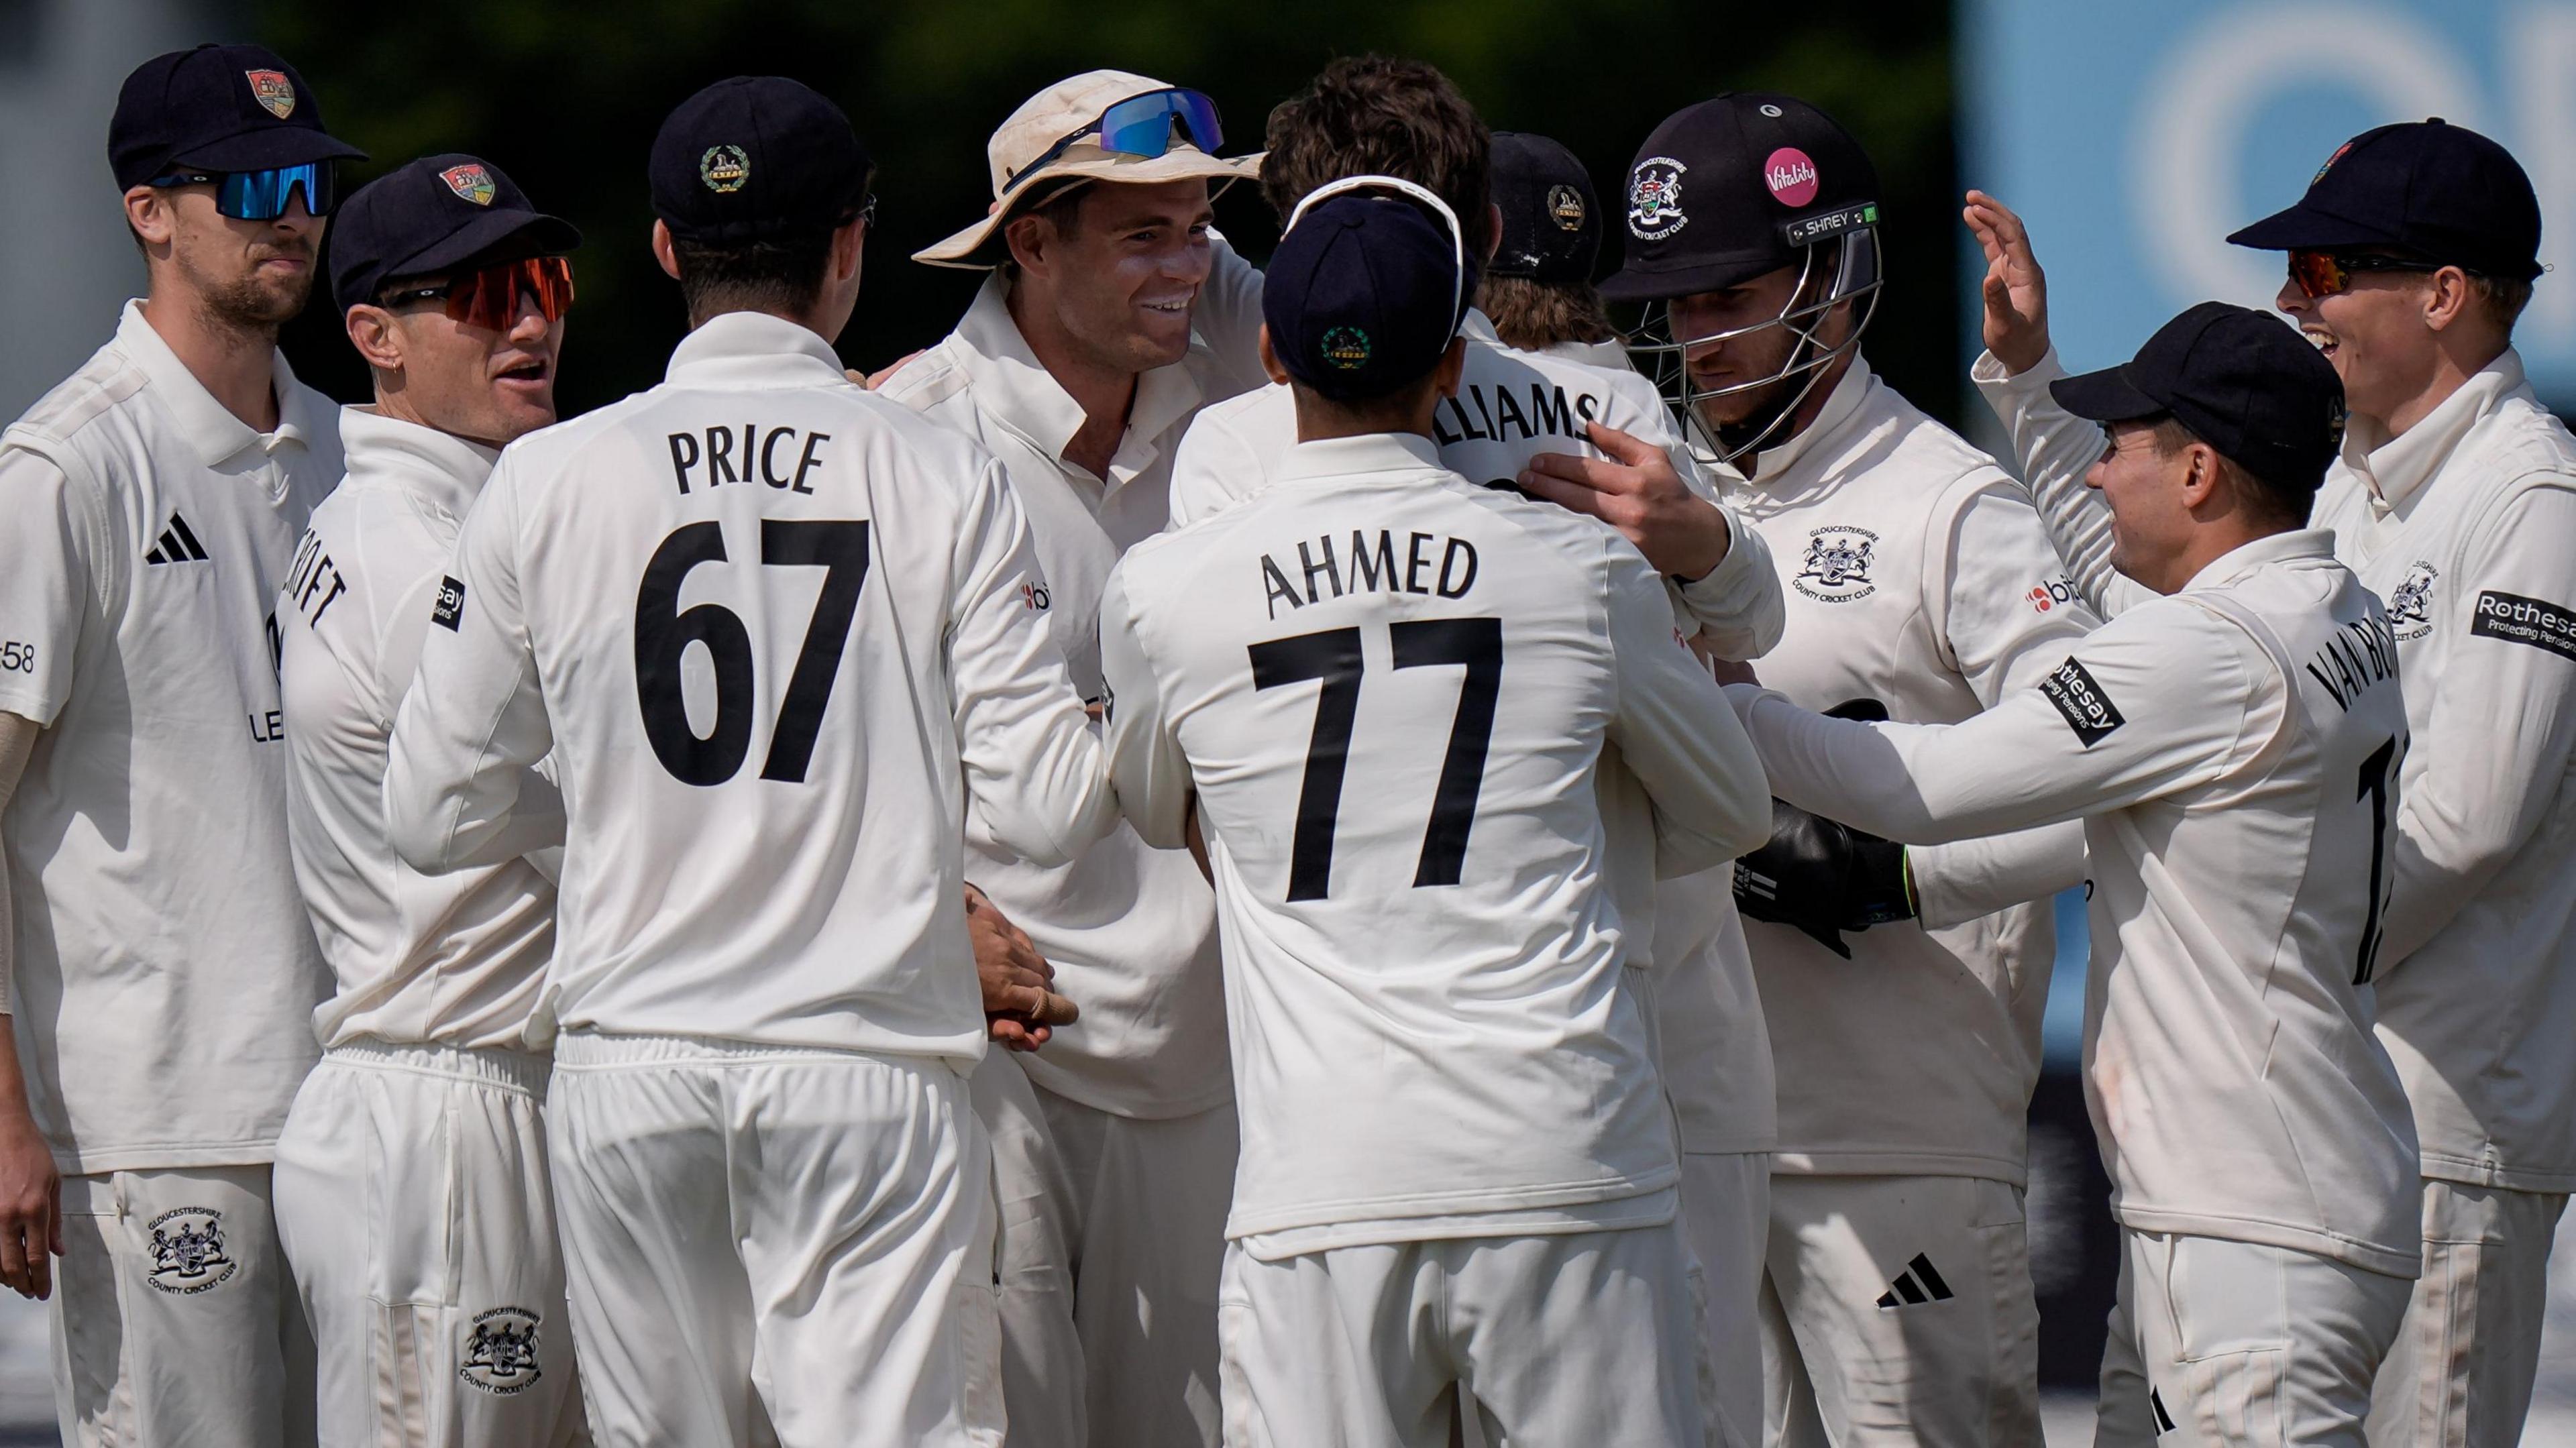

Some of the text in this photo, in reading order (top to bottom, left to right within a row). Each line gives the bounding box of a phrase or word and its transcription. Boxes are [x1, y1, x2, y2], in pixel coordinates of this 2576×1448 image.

[1767, 162, 1816, 191] Vitality
[1670, 215, 1688, 233] CLUB
[1806, 213, 1848, 235] SHREY
[668, 424, 830, 495] PRICE
[1810, 526, 1880, 544] GLOUCESTERSHIRE
[1260, 529, 1479, 620] AHMED
[1792, 579, 1876, 603] COUNTY CRICKET CLUB
[2412, 624, 2433, 638] CLUB
[2488, 619, 2538, 640] Protecting
[0, 641, 34, 673] 58
[635, 520, 869, 787] 67
[2306, 628, 2370, 714] VAN
[2059, 691, 2090, 729] Pensions
[249, 710, 284, 742] LE
[1247, 617, 1504, 903] 77
[148, 1207, 222, 1230] GLOUCESTERSHIRE
[148, 1262, 237, 1294] COUNTY CRICKET CLUB
[472, 1307, 542, 1326] GLOUCESTERSHIRE
[460, 1369, 541, 1394] COUNTY CRICKET CLUB
